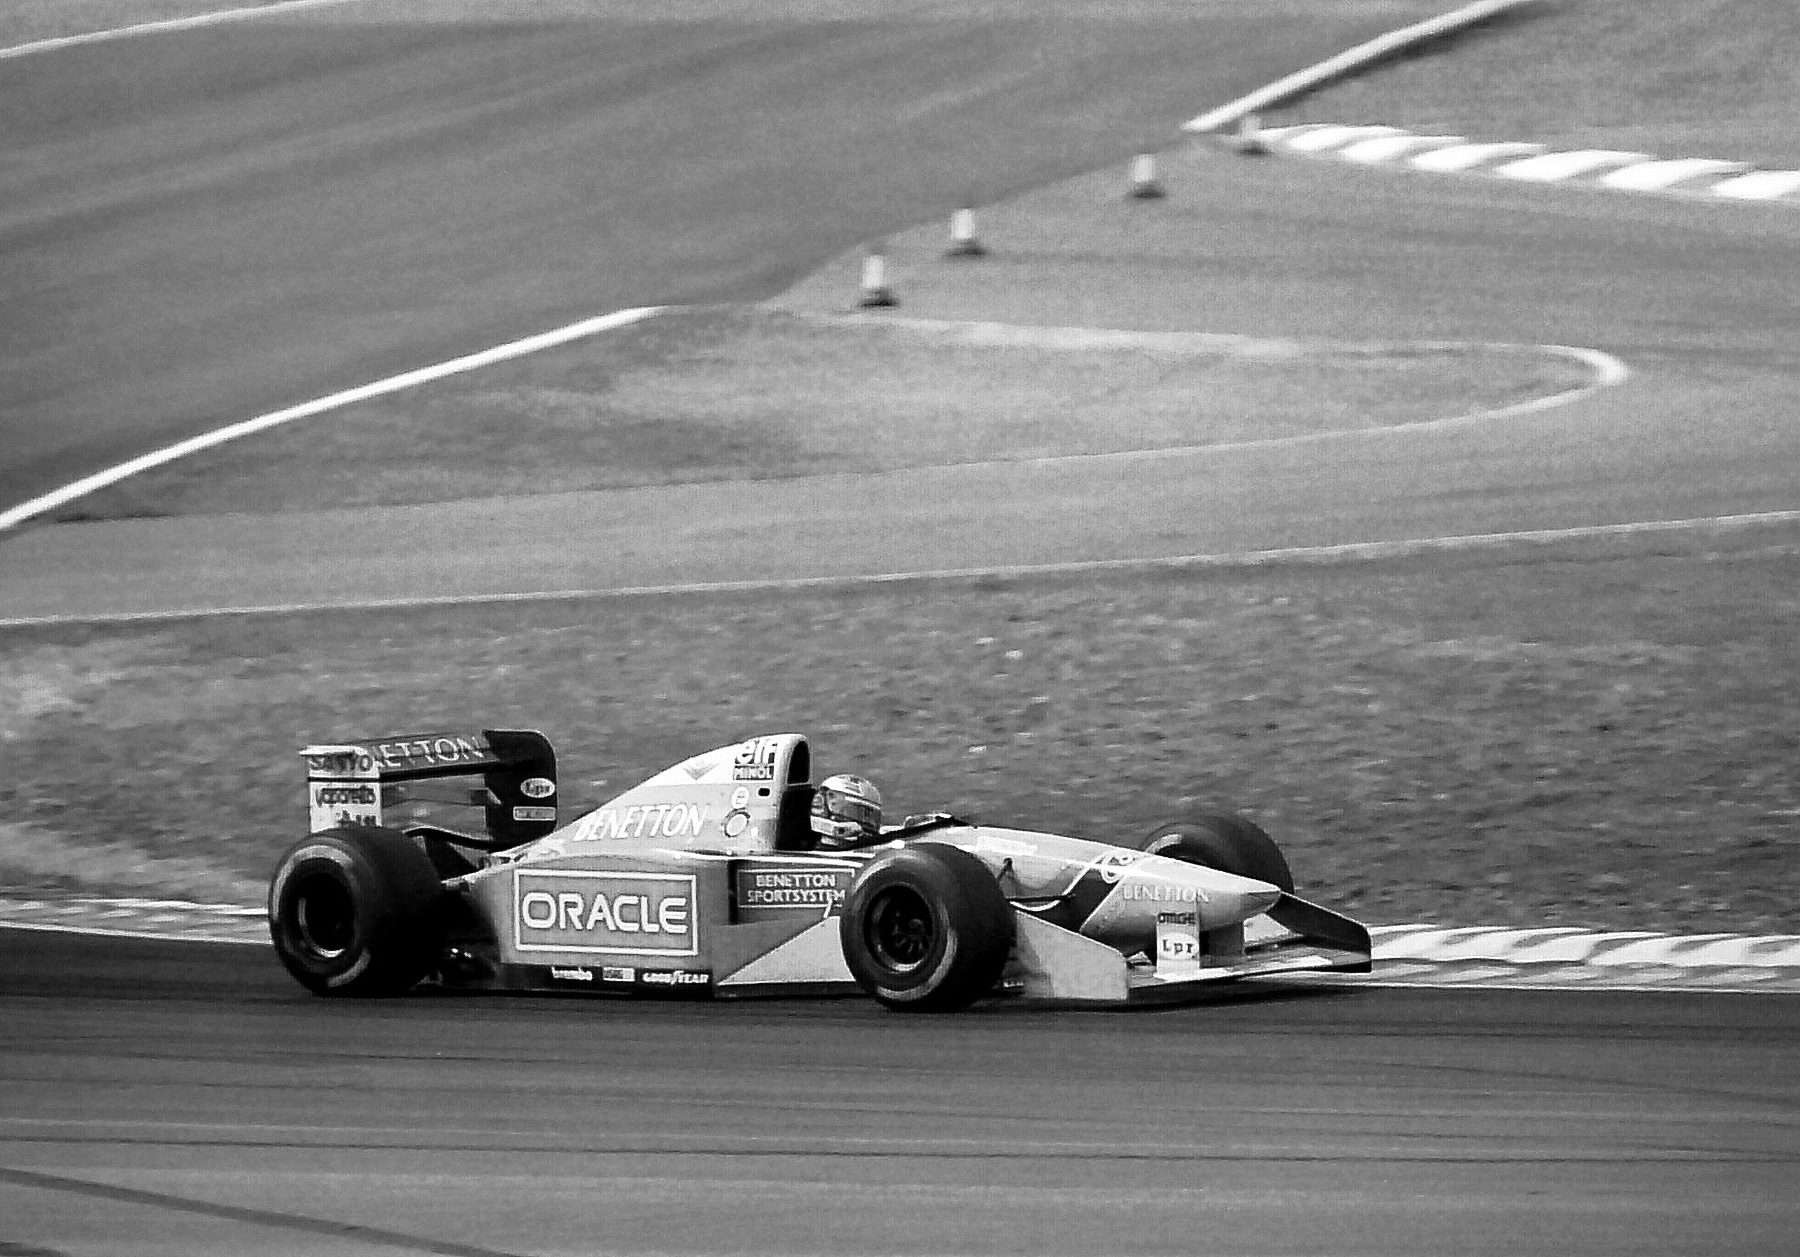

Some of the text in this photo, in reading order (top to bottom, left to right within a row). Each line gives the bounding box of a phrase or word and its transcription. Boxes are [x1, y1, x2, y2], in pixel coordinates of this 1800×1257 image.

[735, 740, 778, 764] elf
[733, 766, 775, 781] MINOL
[572, 802, 711, 841] BENETTON
[756, 874, 836, 887] BENETTON
[747, 889, 846, 903] SPORTSYSTEM
[521, 892, 689, 935] ORACLE
